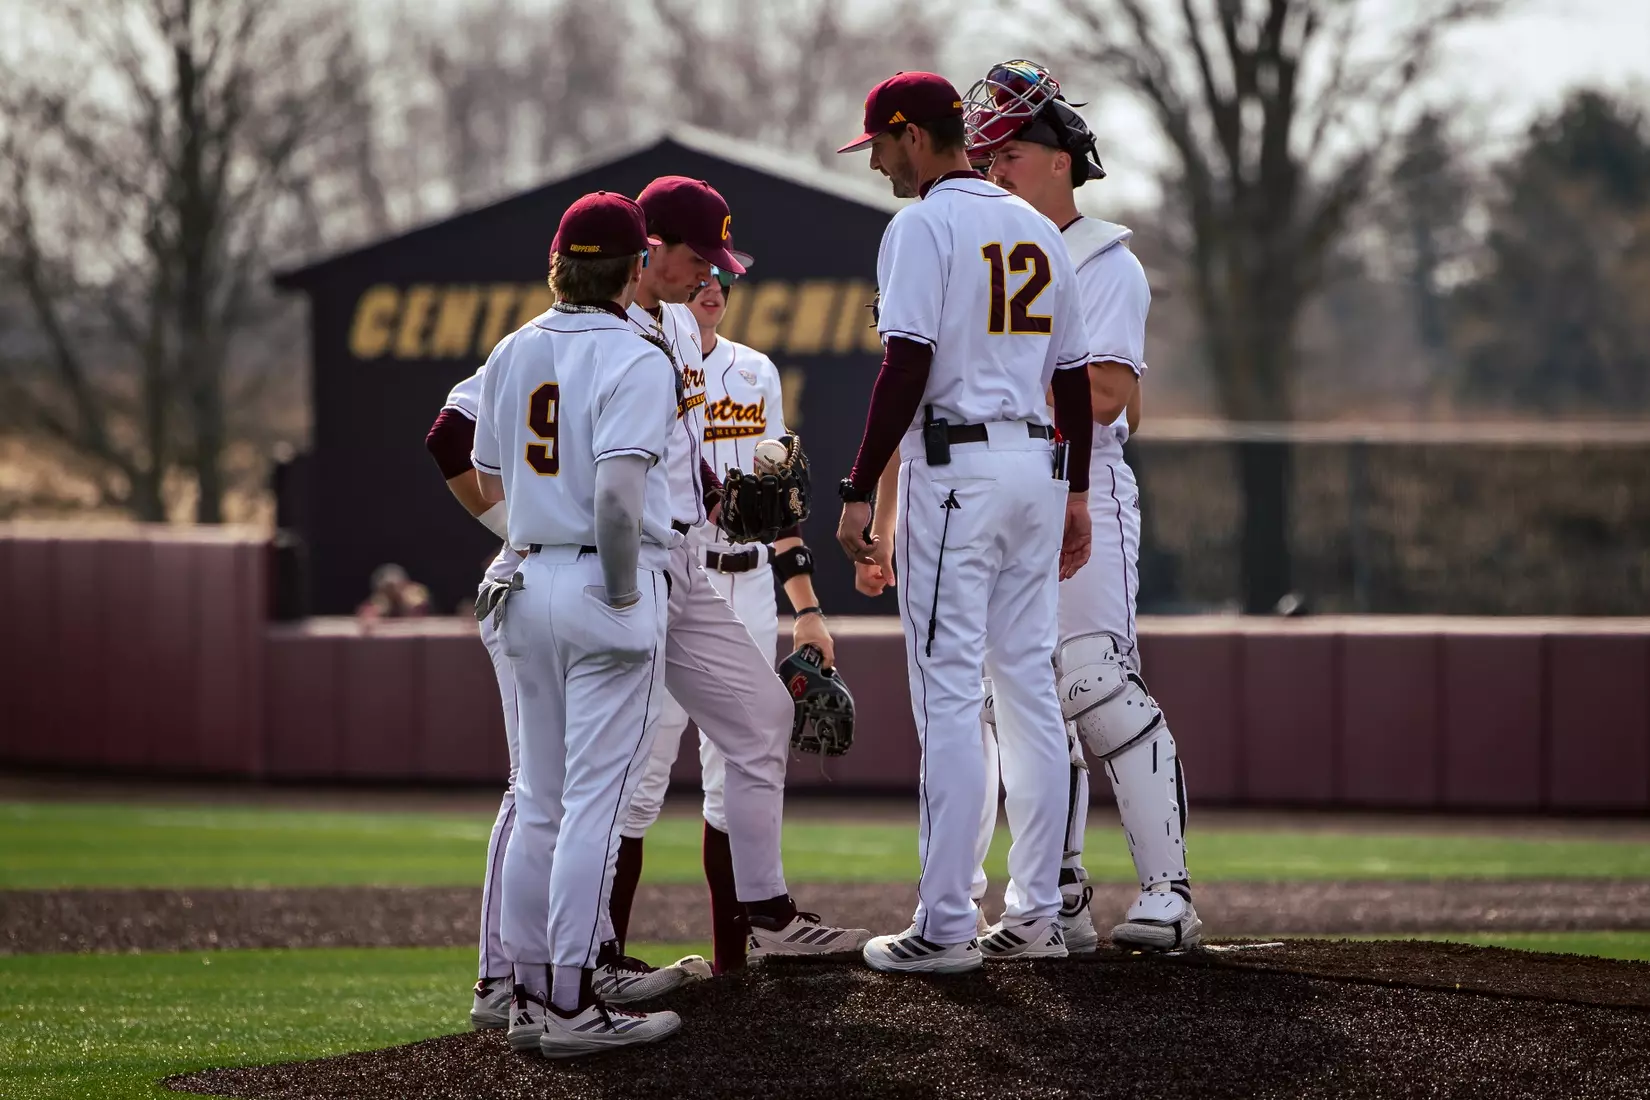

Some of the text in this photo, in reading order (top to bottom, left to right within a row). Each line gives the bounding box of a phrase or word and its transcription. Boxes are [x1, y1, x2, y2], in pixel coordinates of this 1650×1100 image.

[980, 241, 1053, 335] 12
[524, 381, 561, 477] 9
[704, 395, 767, 426] ntral
[705, 427, 756, 438] CHIGAN
